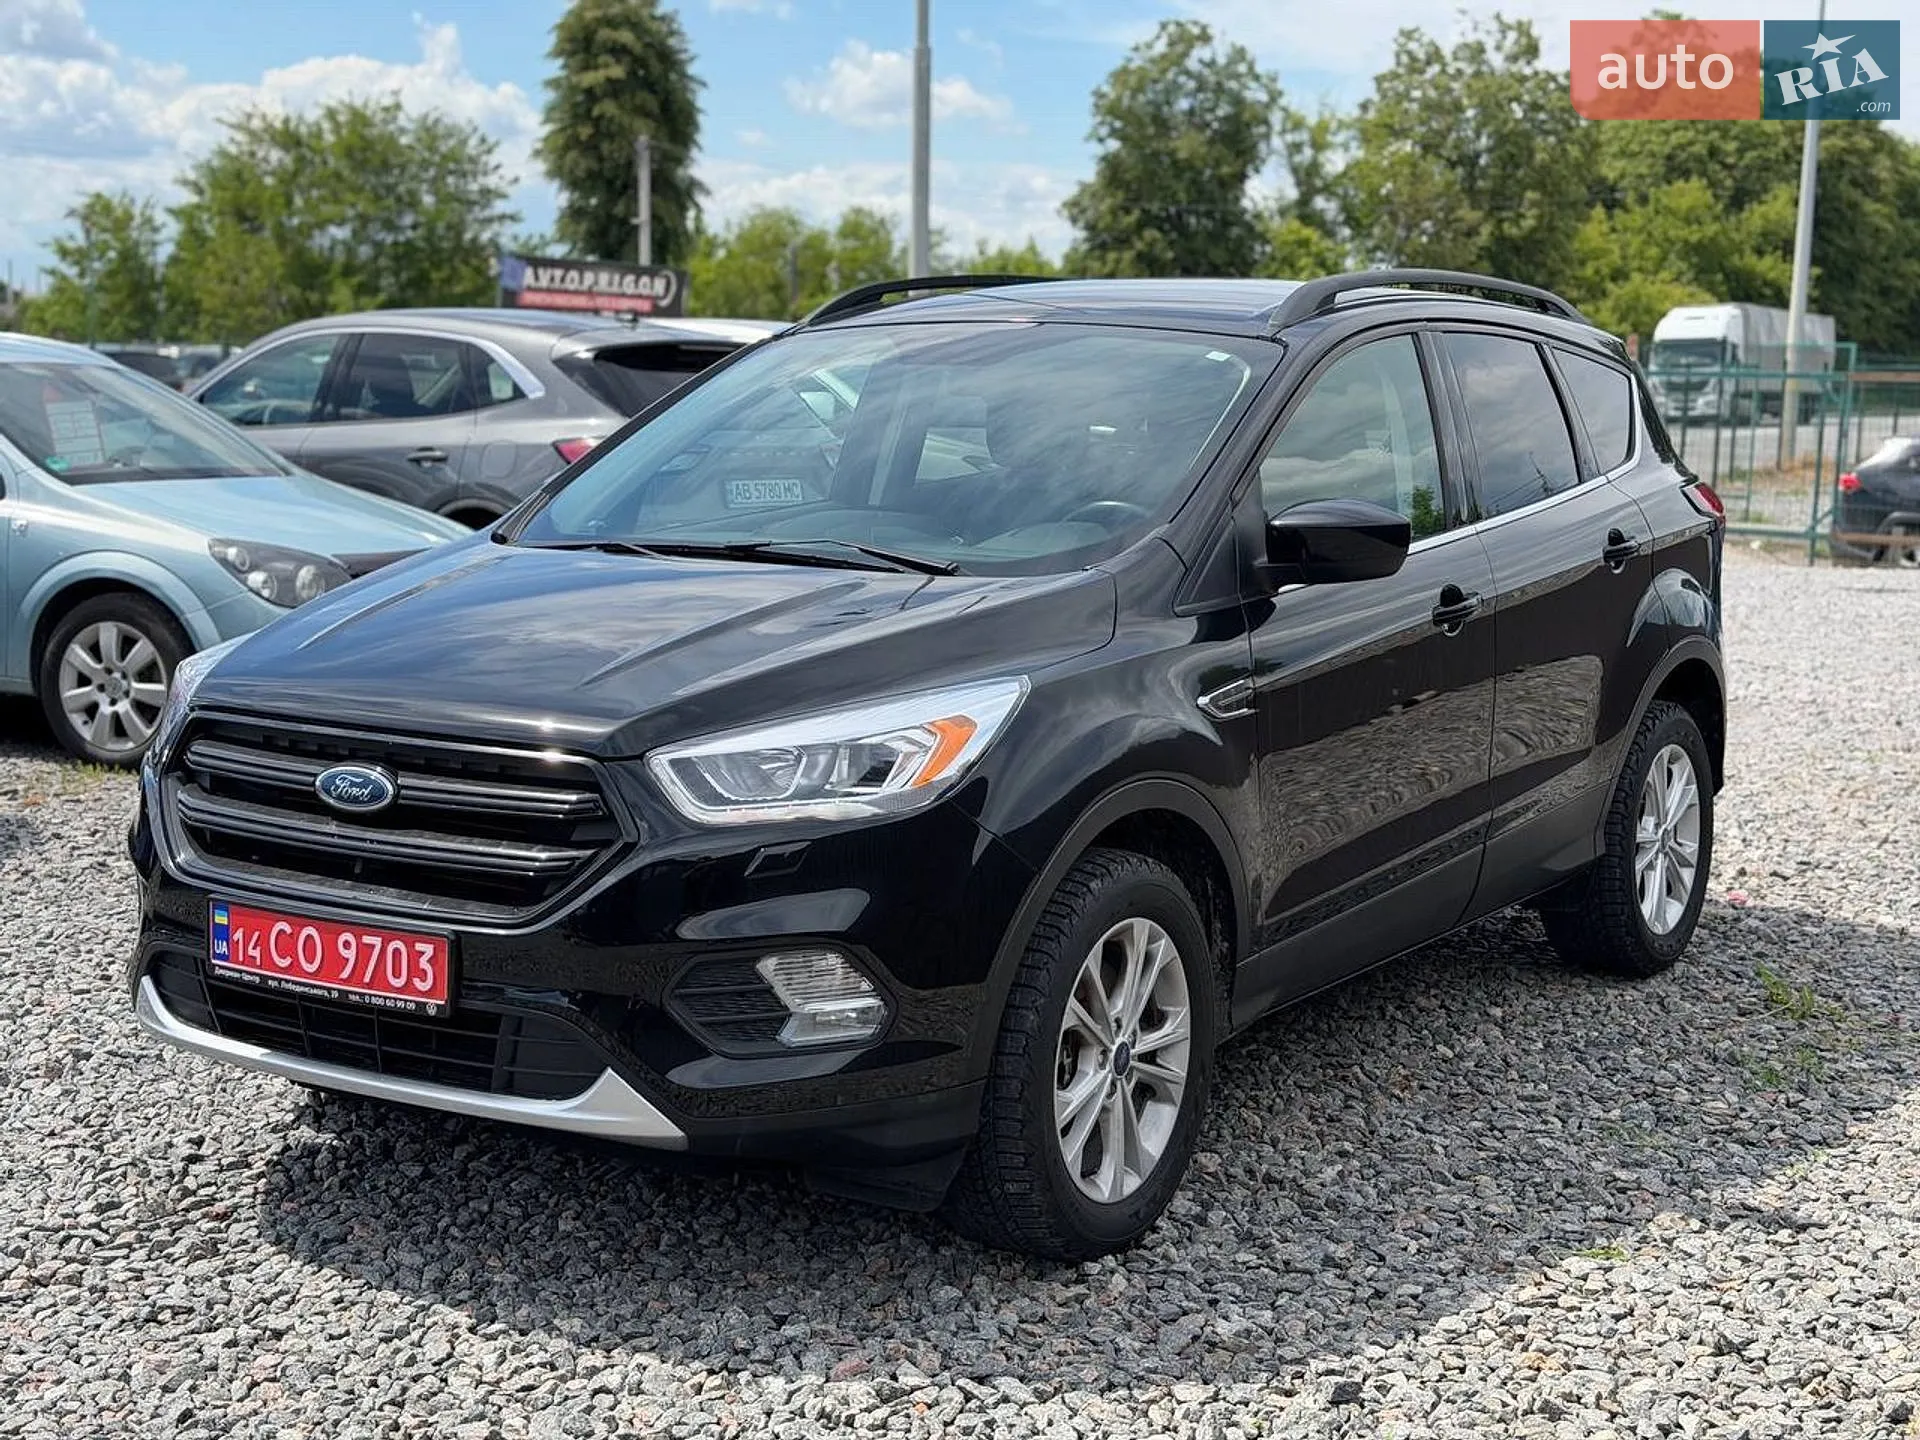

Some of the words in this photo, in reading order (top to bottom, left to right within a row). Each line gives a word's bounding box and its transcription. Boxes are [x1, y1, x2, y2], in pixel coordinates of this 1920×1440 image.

[331, 774, 373, 801] Ford
[214, 938, 229, 955] UA
[338, 932, 434, 992] 9703
[371, 996, 385, 1006] 800
[386, 998, 396, 1007] 60
[406, 1002, 416, 1010] 09
